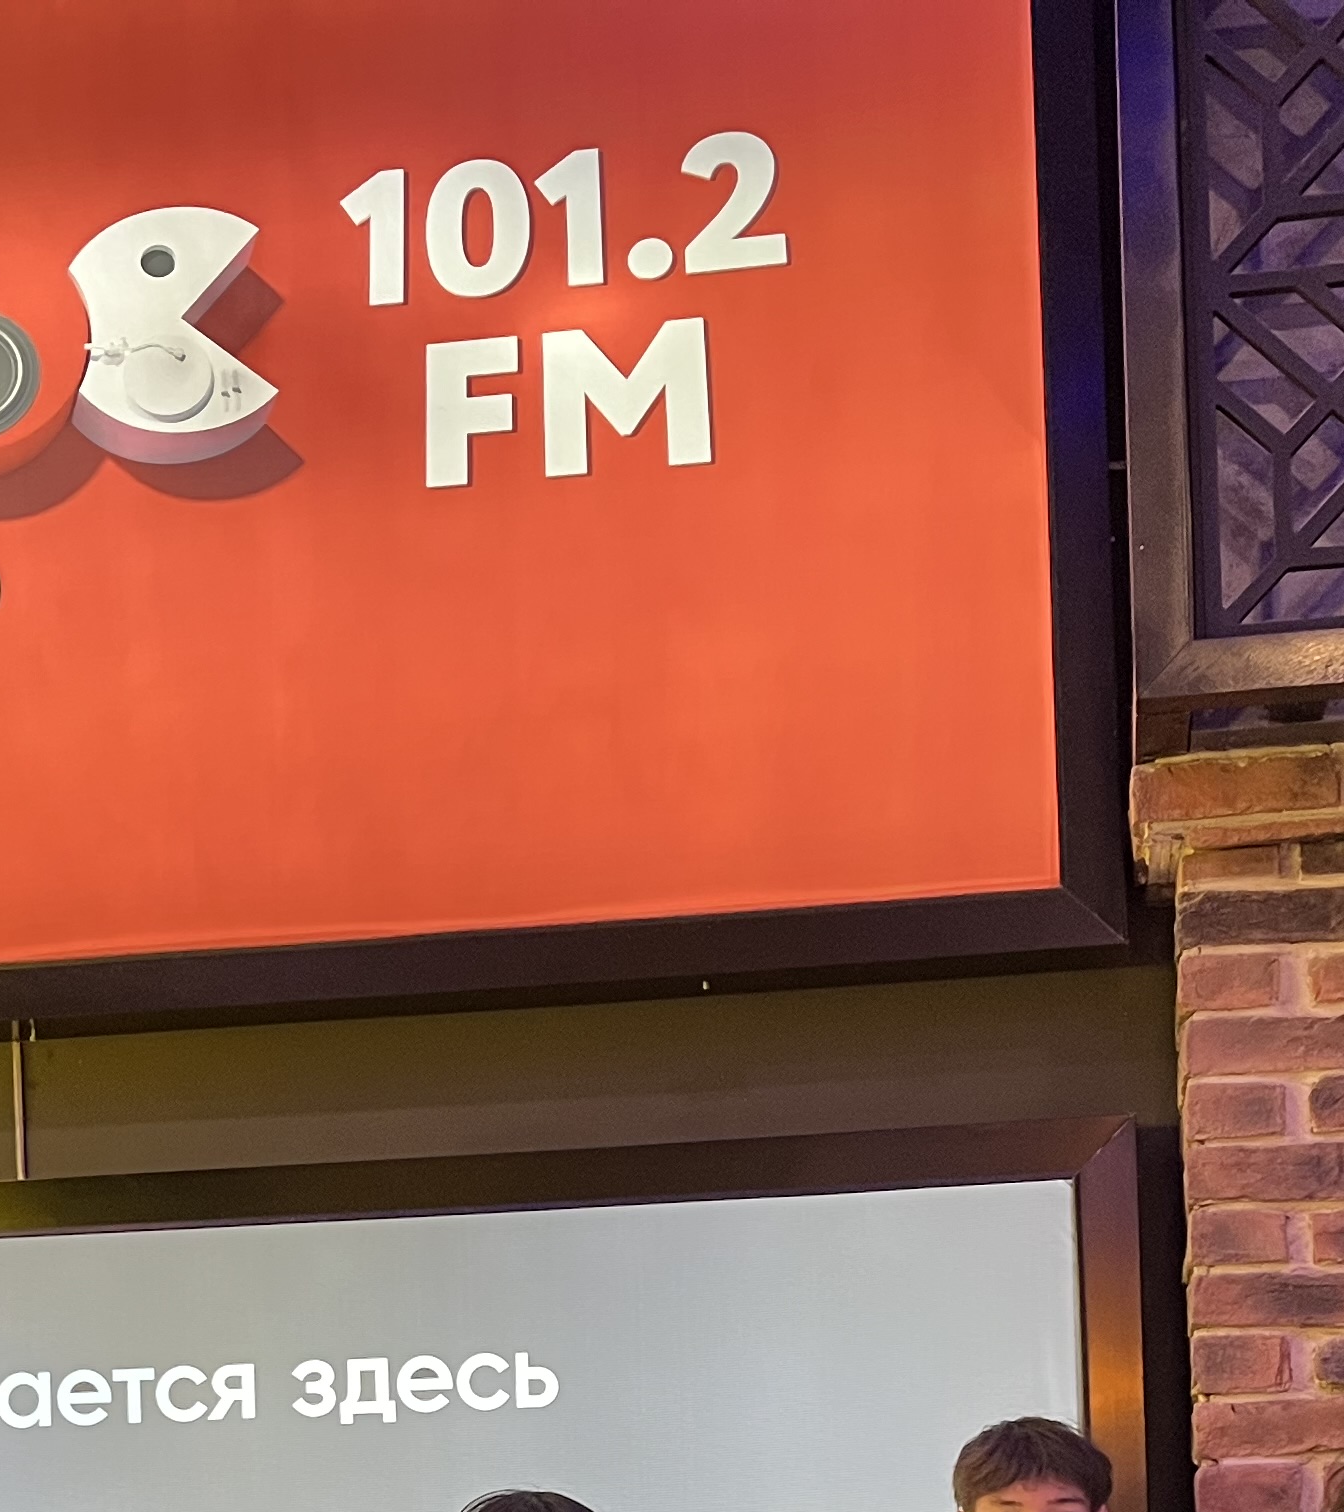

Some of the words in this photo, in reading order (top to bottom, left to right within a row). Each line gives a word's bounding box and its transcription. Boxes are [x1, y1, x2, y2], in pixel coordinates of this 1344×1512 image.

[339, 131, 788, 307] 101.2
[425, 317, 713, 489] FM
[290, 1351, 560, 1426] здесь
